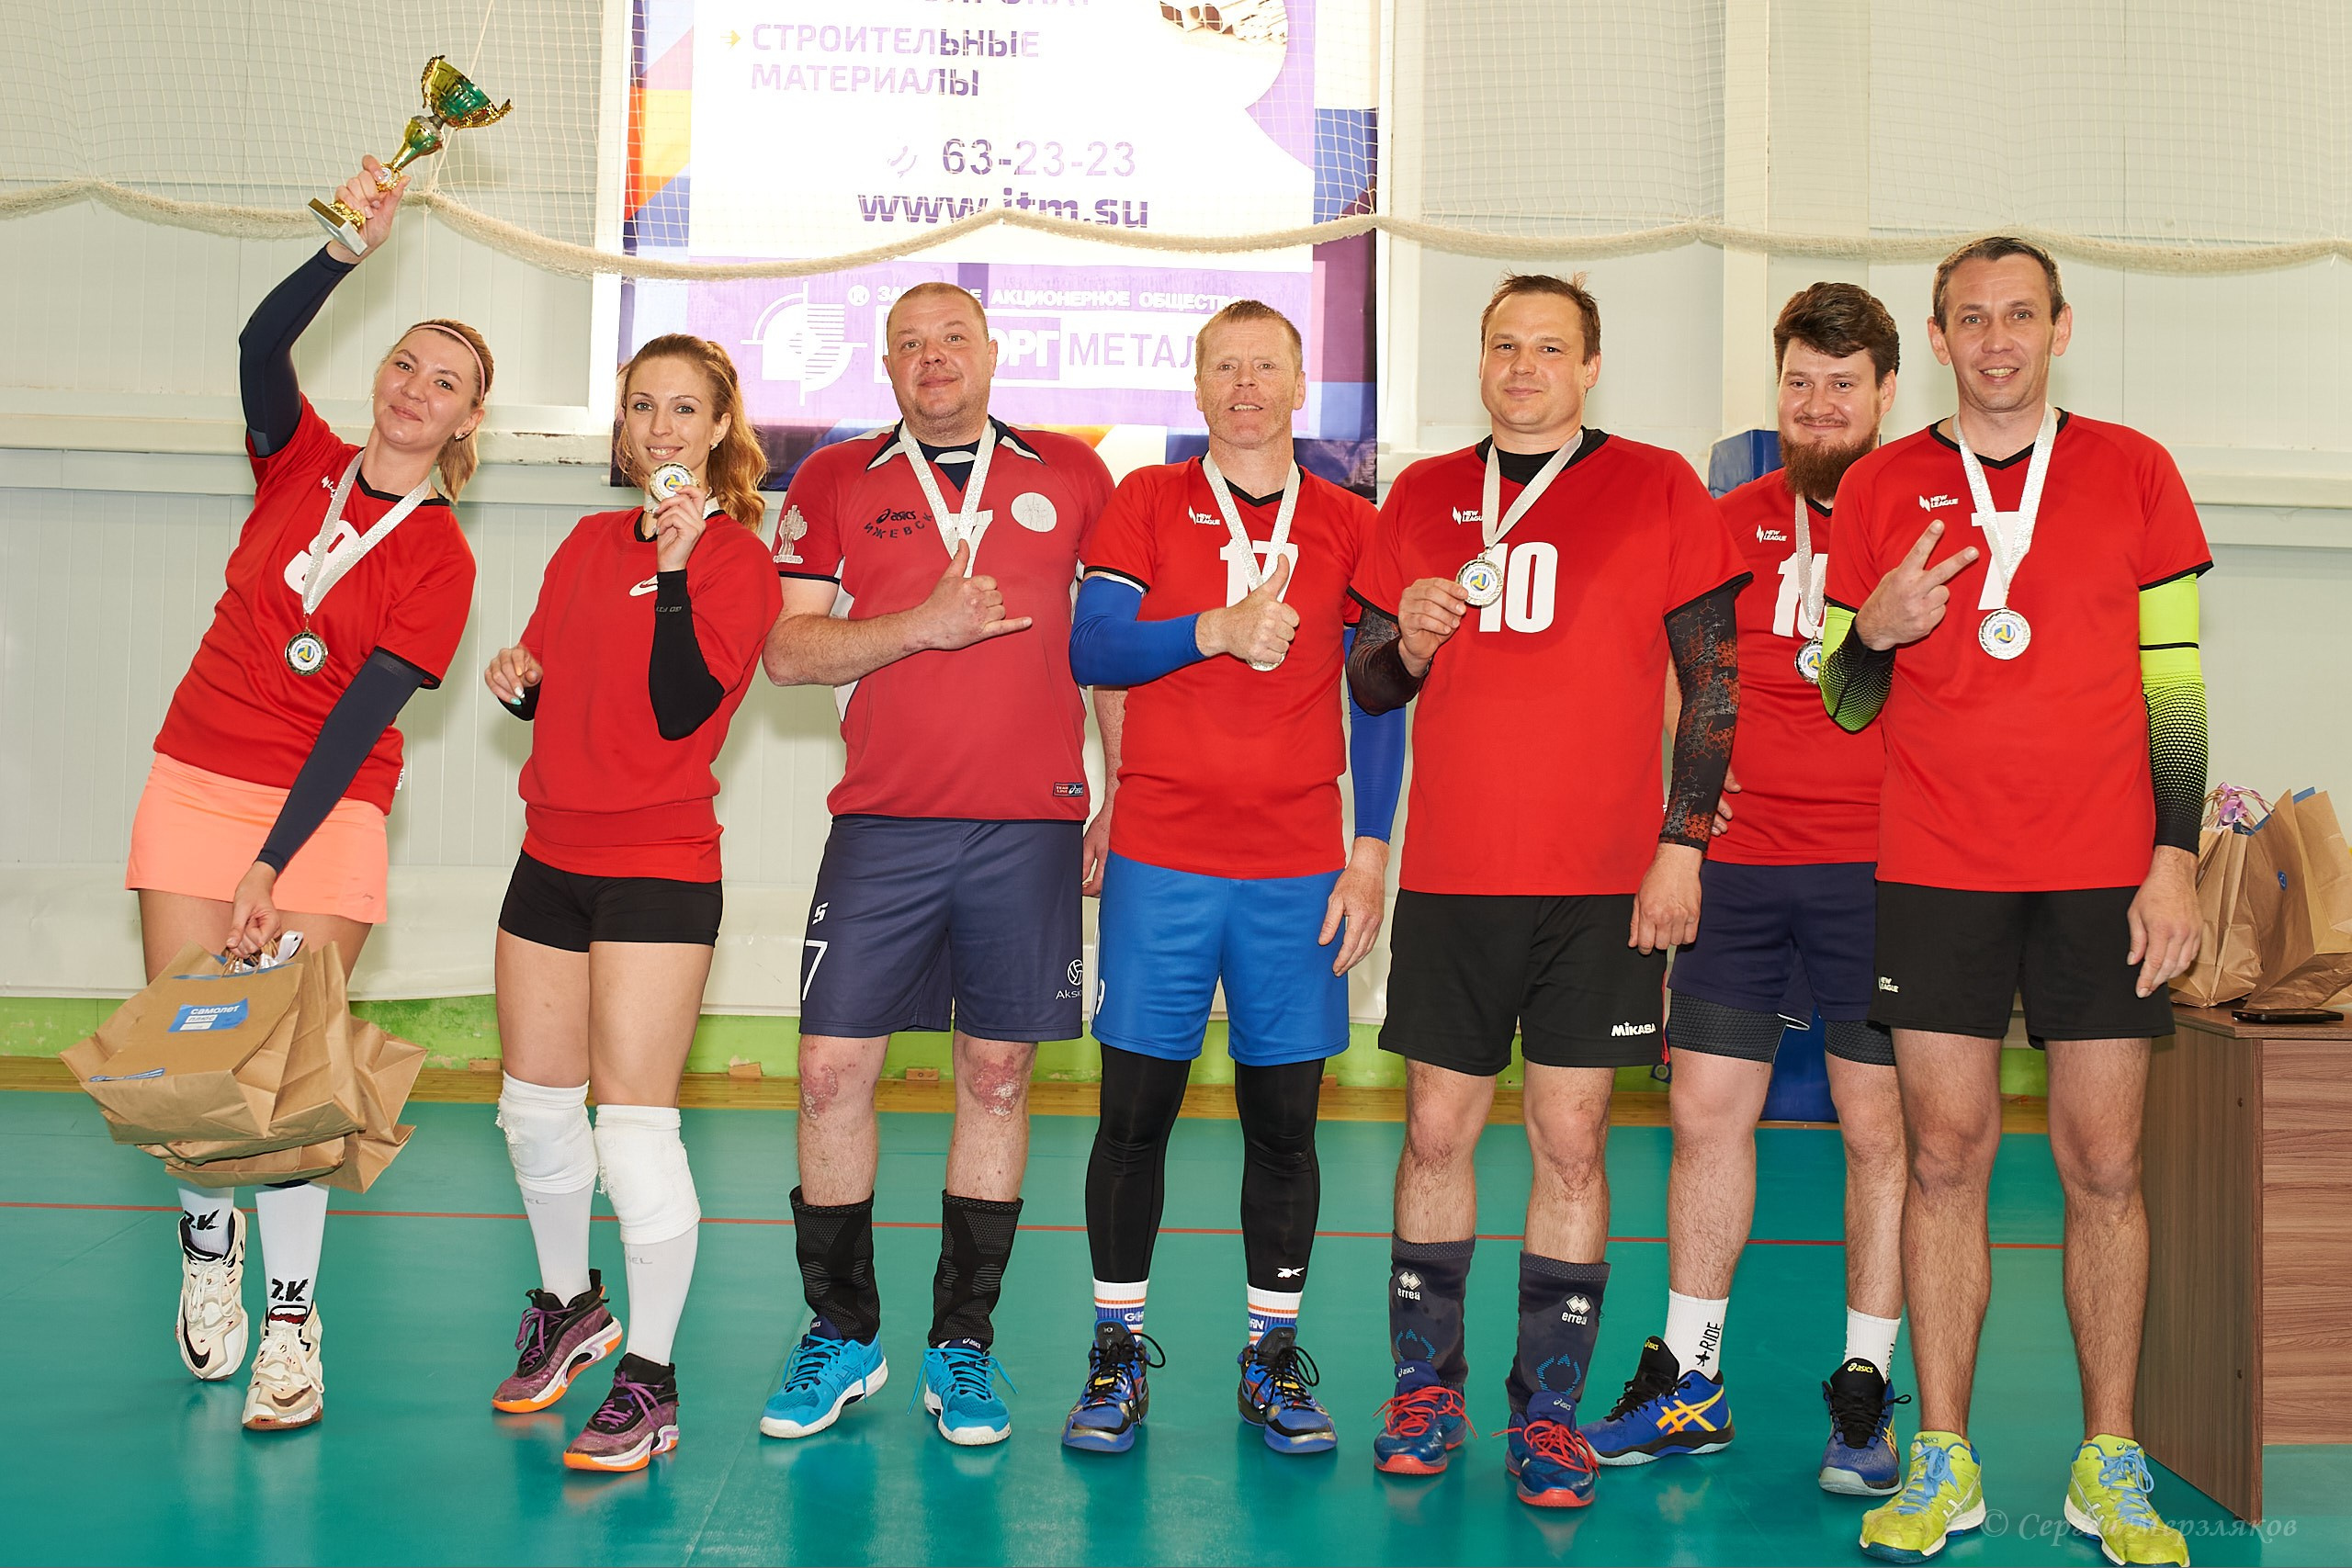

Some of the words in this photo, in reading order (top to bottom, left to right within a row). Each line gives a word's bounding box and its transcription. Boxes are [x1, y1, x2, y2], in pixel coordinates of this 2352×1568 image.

[752, 24, 1039, 57] СТРОИТЕЛЬНЫЕ
[752, 64, 979, 96] МАТЕРИАЛЫ
[943, 138, 1136, 177] 63-23-23
[857, 187, 1148, 228] wwwitm.su
[991, 289, 1131, 309] АКЦИОНЕРНОЕ
[1138, 291, 1243, 310] ОБЩЕСТВ
[1477, 541, 1559, 634] 10
[800, 939, 829, 1001] 7
[190, 1005, 241, 1015] самолет
[1699, 1321, 1724, 1352] RIDE
